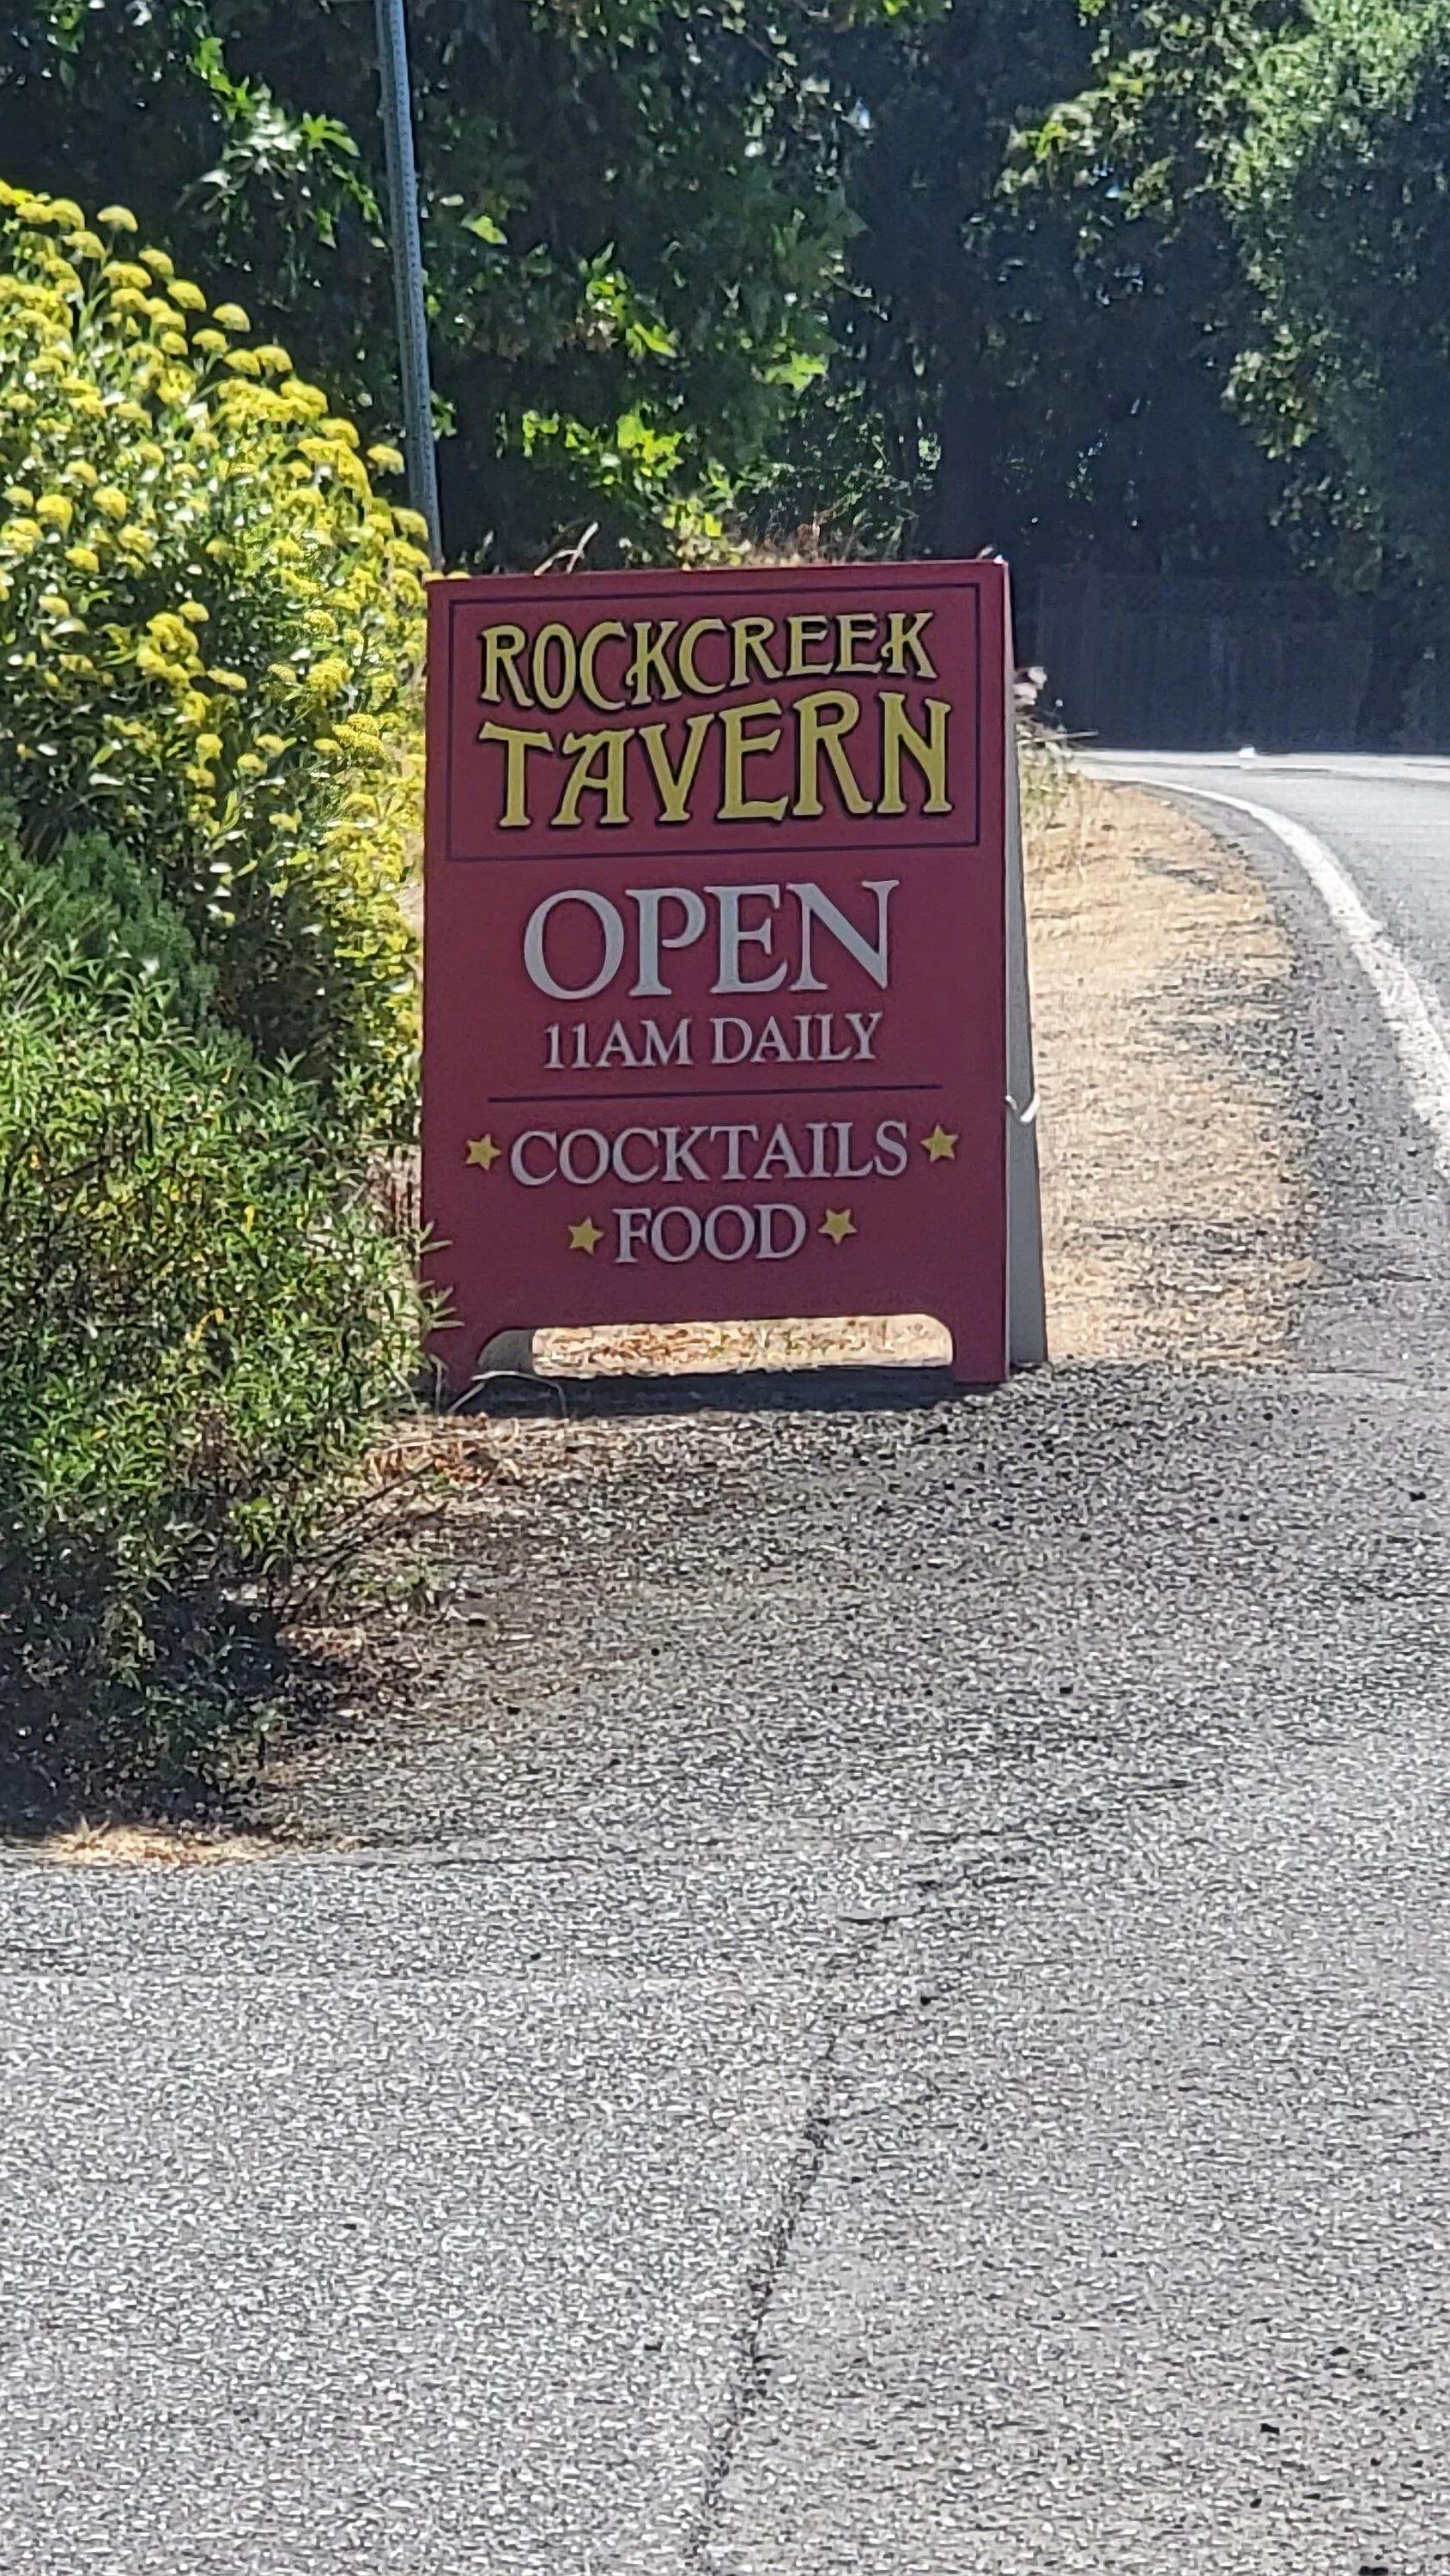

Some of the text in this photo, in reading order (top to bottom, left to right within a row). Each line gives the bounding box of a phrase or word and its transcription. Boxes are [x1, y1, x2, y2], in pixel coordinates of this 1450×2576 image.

[479, 611, 937, 712] ROCKCREEK
[478, 690, 953, 829] TAVERN
[523, 878, 901, 1000] OPEN
[543, 1012, 883, 1070] 11AM DAILY
[510, 1119, 909, 1187] COCKTAILS
[613, 1203, 807, 1265] FOOD
